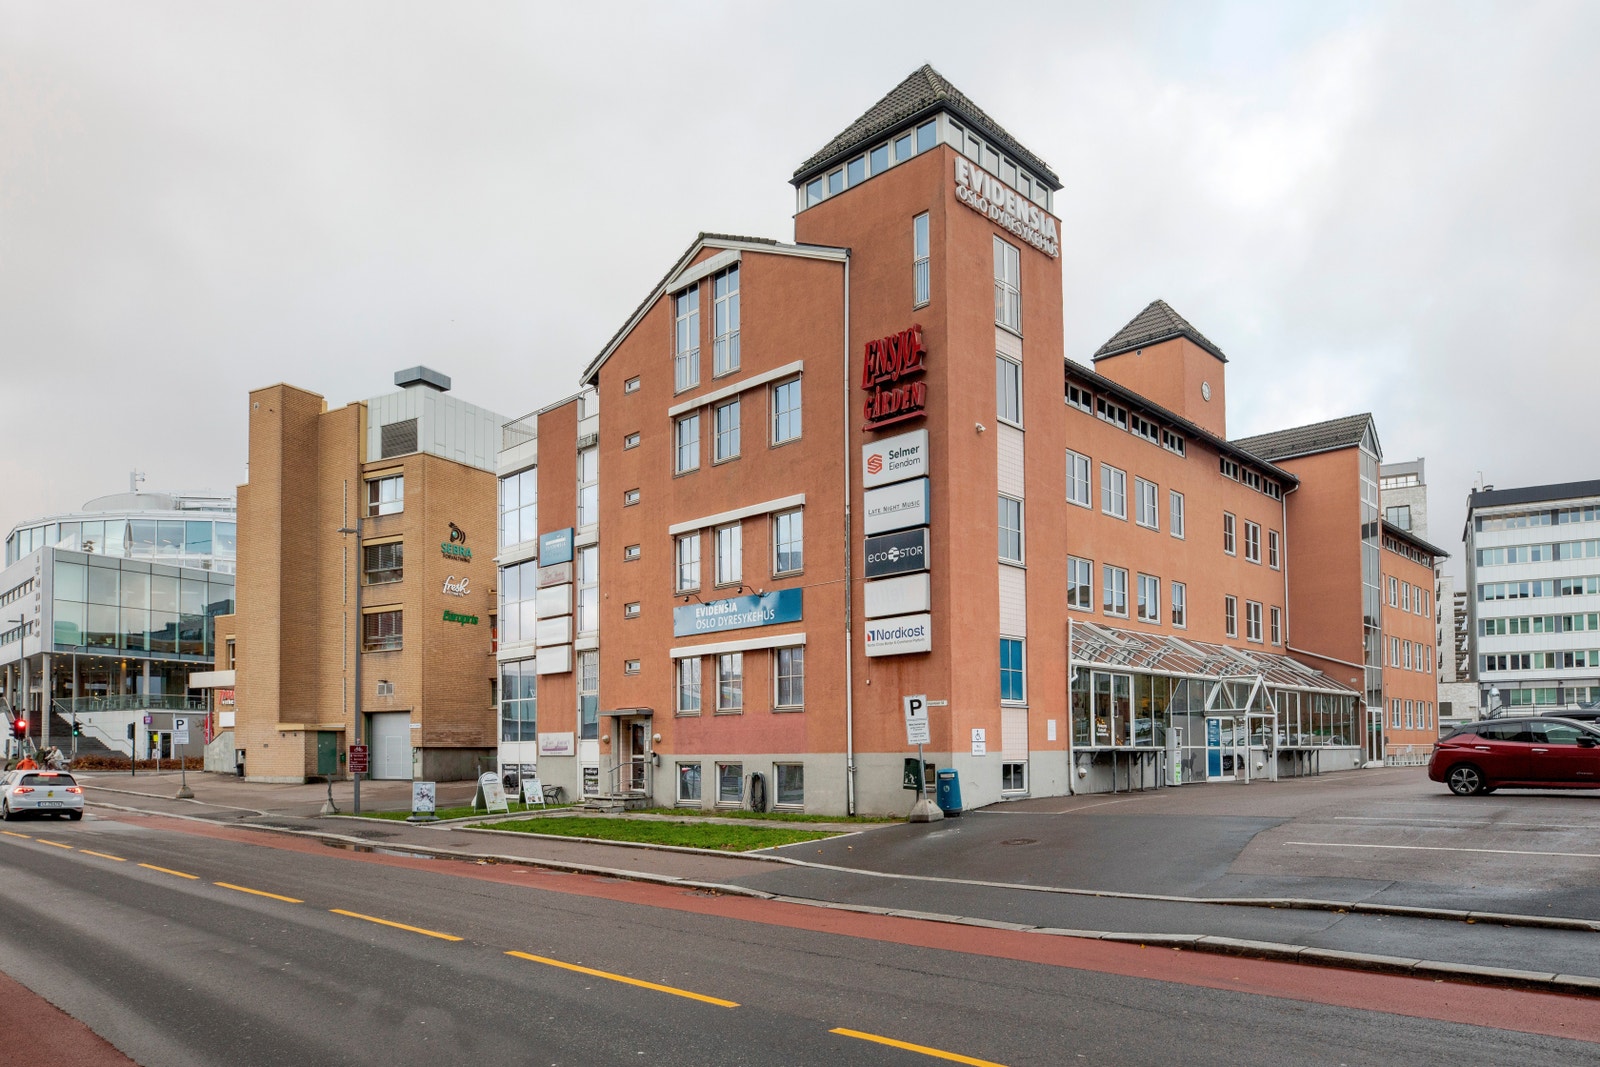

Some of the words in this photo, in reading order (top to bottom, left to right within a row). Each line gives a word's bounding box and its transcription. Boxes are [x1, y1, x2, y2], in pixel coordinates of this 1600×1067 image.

[955, 156, 1059, 244] EVIDENSIA
[956, 184, 988, 213] OSLO
[988, 204, 1059, 258] DYRESYKEHUS
[888, 445, 920, 460] Selmer
[888, 457, 921, 471] Eiendom
[883, 504, 900, 512] NIGHT
[902, 500, 921, 508] MUSIC
[441, 541, 472, 559] SEBRA
[442, 575, 471, 594] fresh
[695, 602, 738, 618] EVIDENSIA
[695, 617, 716, 630] OSLO
[718, 608, 776, 627] DYRESYKEHUS
[876, 625, 925, 641] Nordkost
[909, 699, 922, 716] P
[176, 719, 185, 730] P
